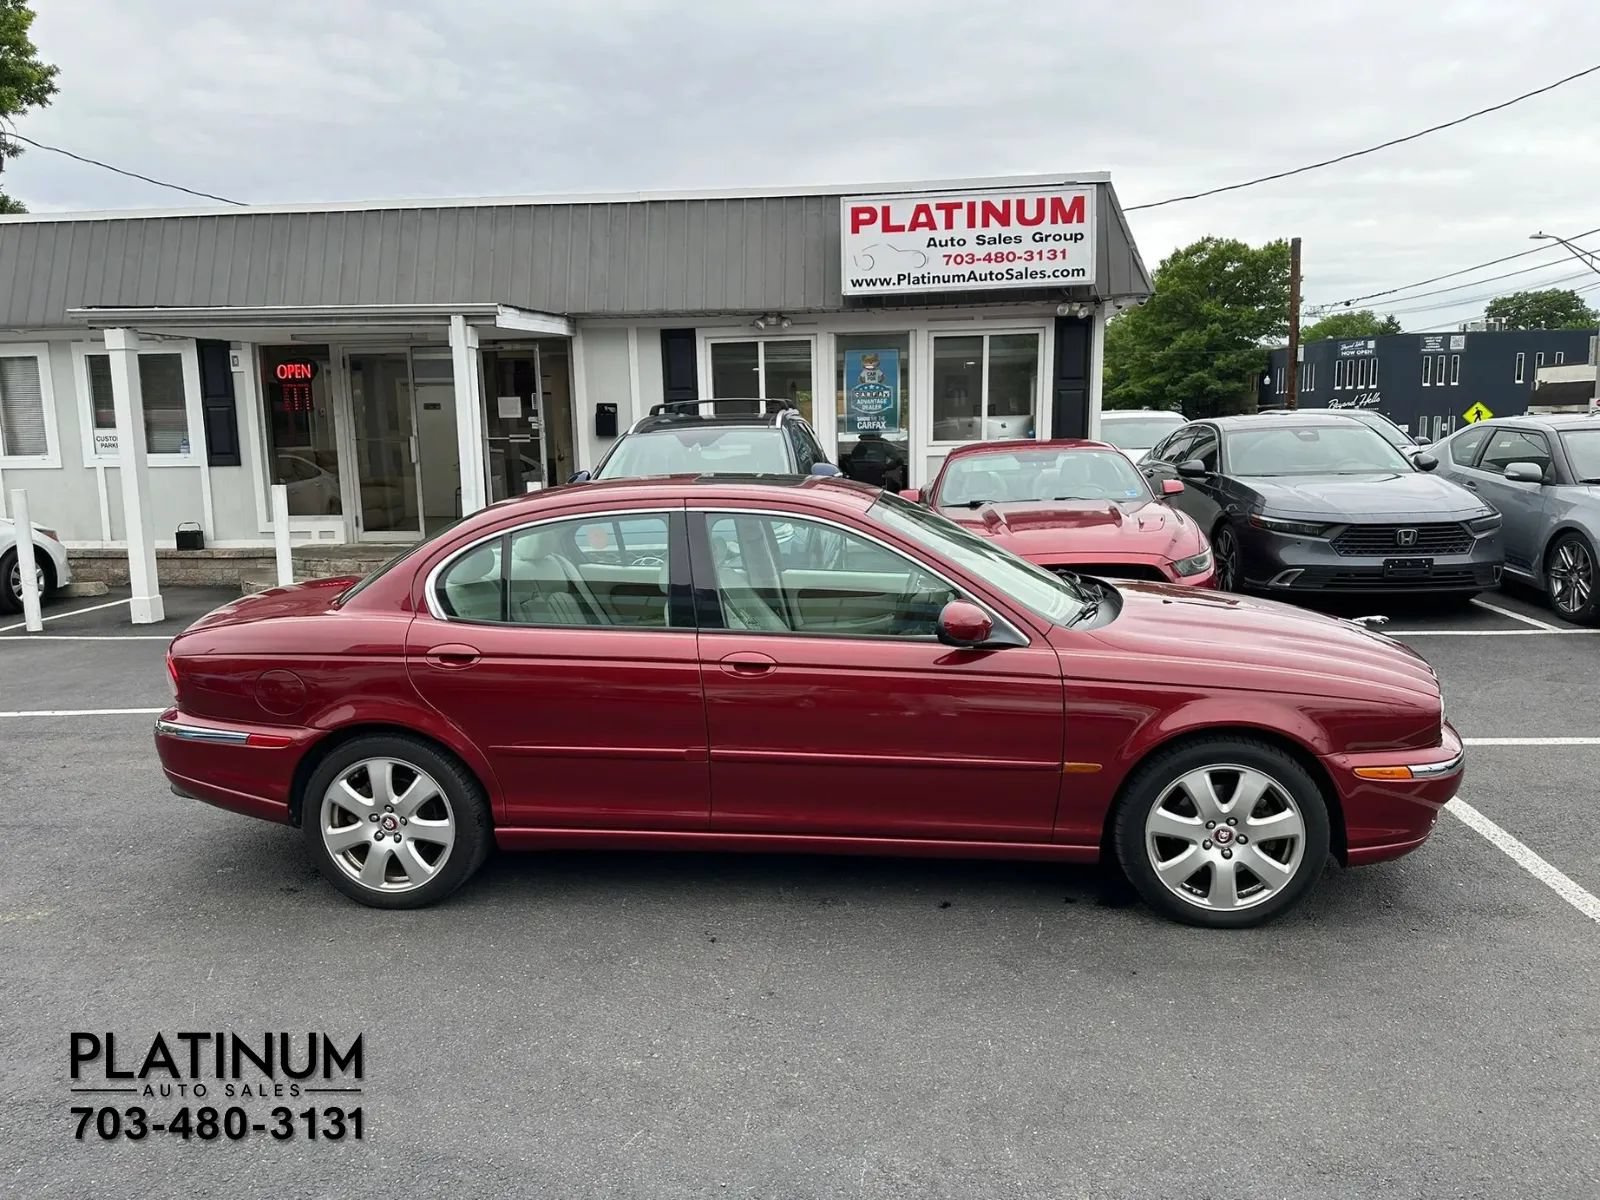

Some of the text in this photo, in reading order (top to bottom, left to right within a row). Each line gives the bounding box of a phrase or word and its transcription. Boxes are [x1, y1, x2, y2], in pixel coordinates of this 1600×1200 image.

[850, 195, 1085, 234] PLATINUM
[926, 231, 1085, 248] Auto Sales Group
[942, 248, 1067, 266] 703-480-3131
[851, 267, 1086, 288] www.PlatinumAutoSales.com
[276, 364, 311, 379] OPEN
[857, 421, 887, 429] CARFAX
